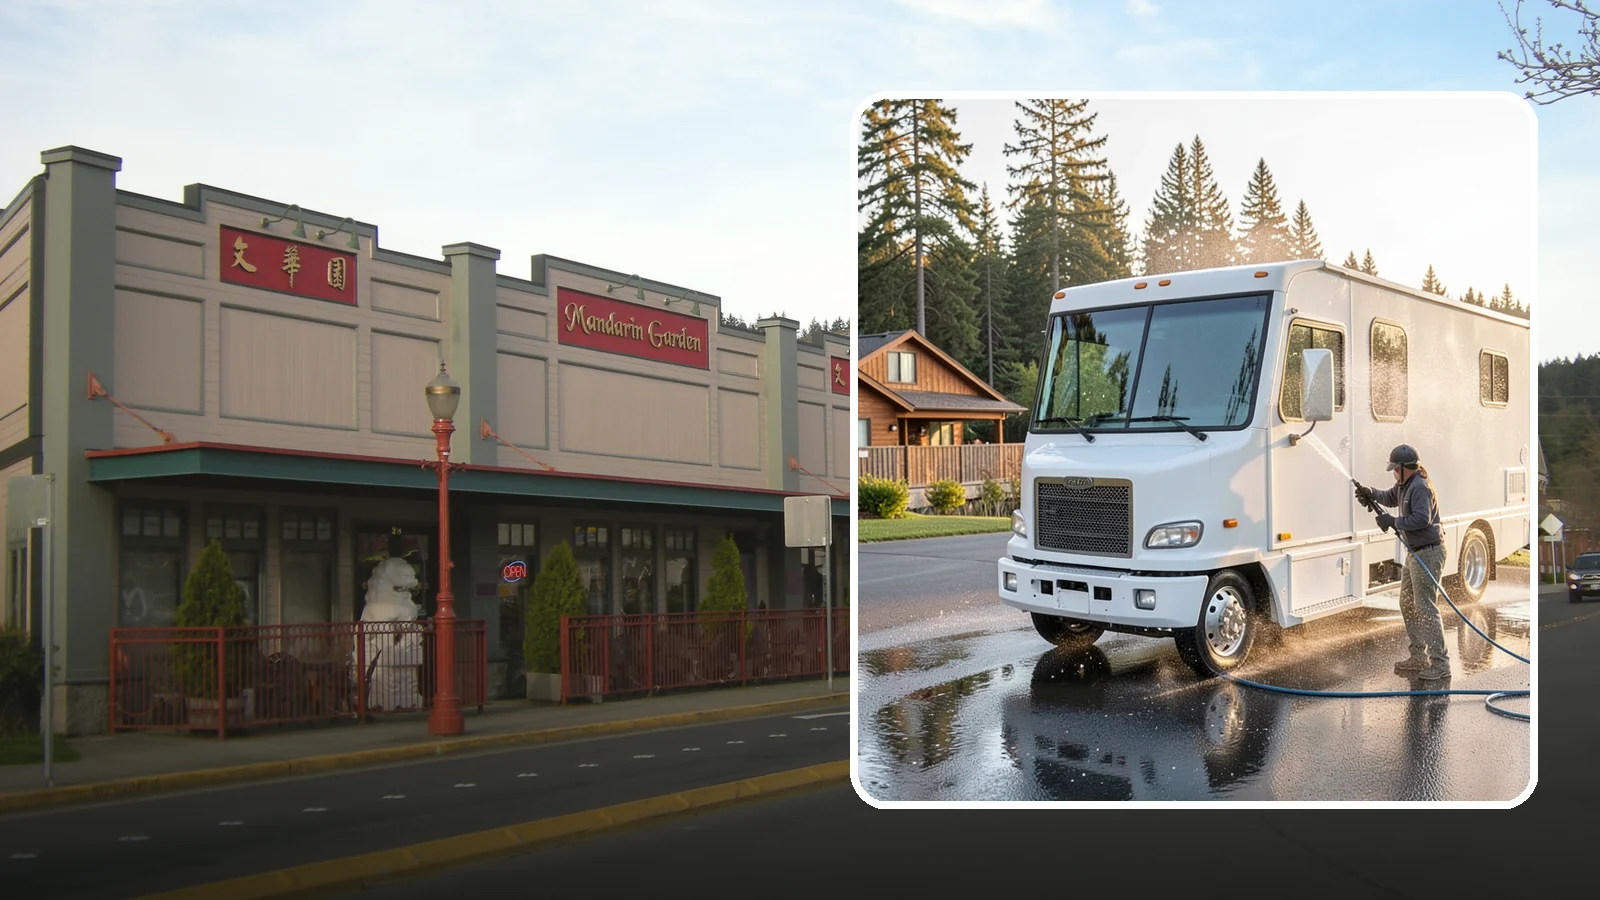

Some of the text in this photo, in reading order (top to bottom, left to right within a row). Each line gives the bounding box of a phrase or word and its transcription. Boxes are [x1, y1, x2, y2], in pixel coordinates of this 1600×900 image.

[230, 235, 346, 291] 文華園
[564, 302, 702, 352] Mandarin Garden
[503, 565, 527, 578] OPEN
